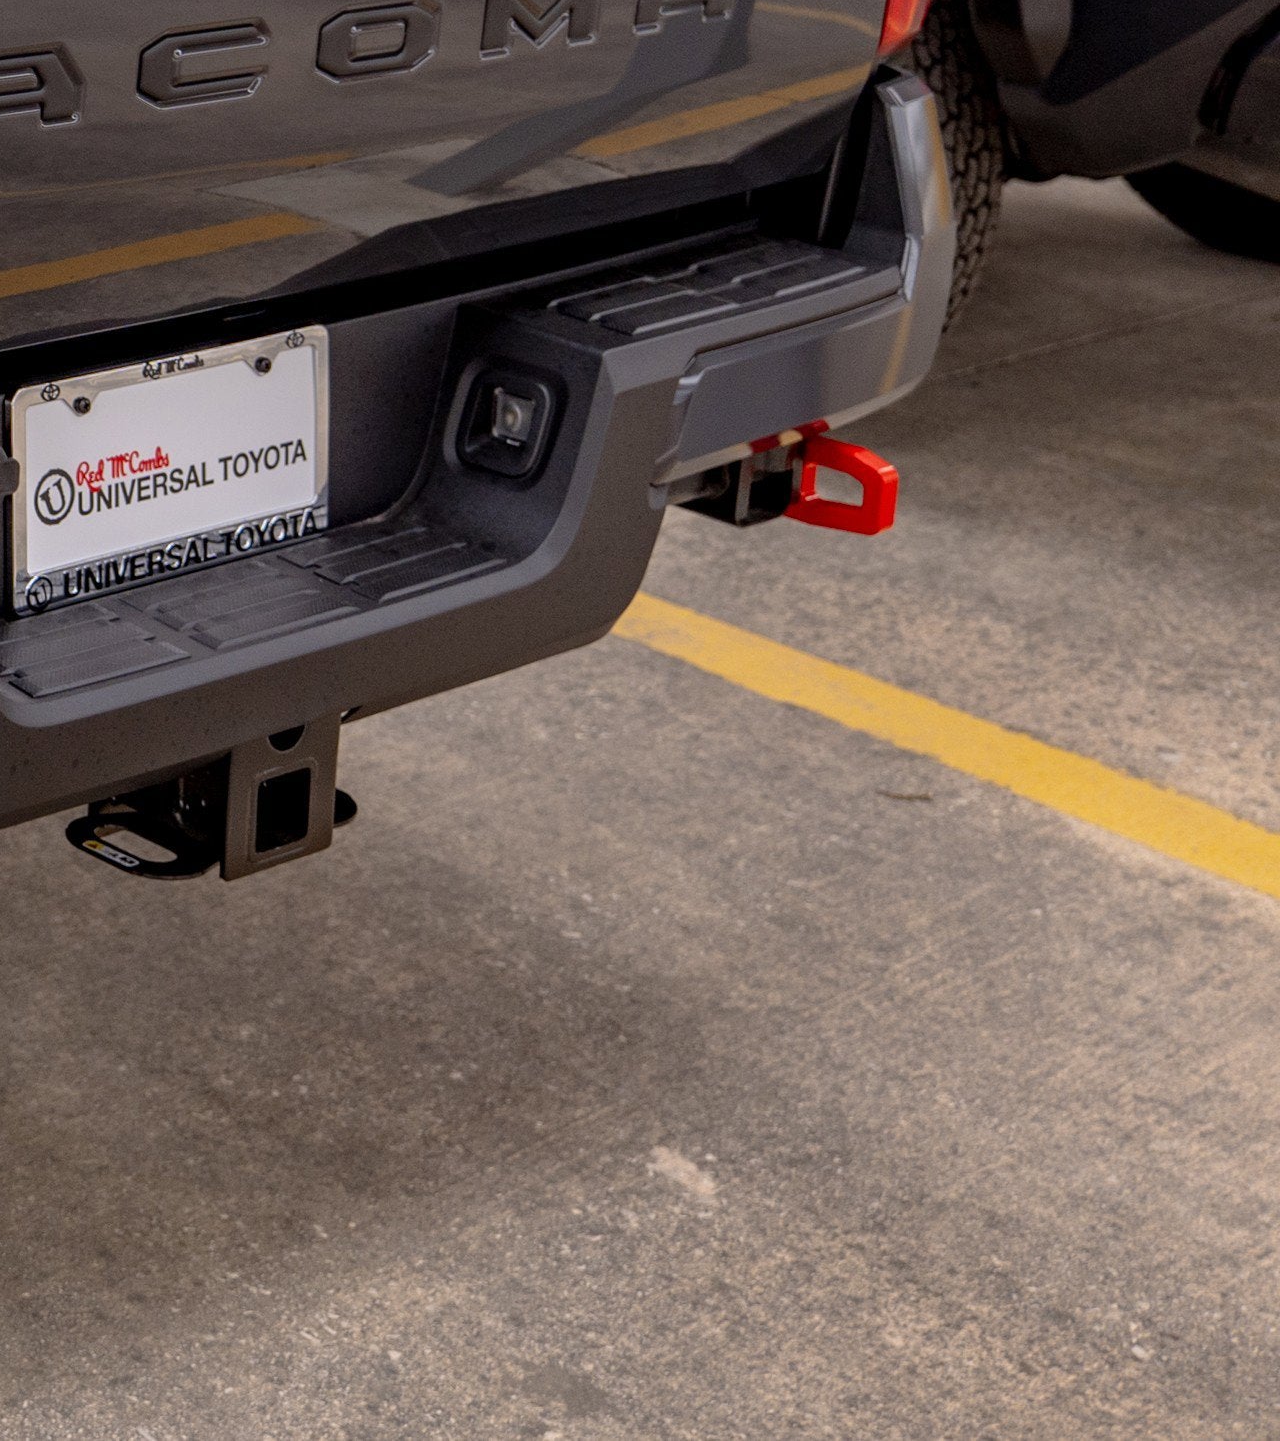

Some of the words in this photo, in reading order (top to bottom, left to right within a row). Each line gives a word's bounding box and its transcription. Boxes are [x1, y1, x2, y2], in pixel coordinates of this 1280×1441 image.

[76, 461, 104, 492] Red
[78, 469, 214, 516] UNIVERSAL
[219, 439, 307, 482] TOYOTA
[63, 537, 217, 597] UNIVERSAL
[223, 508, 320, 555] TOYOTA
